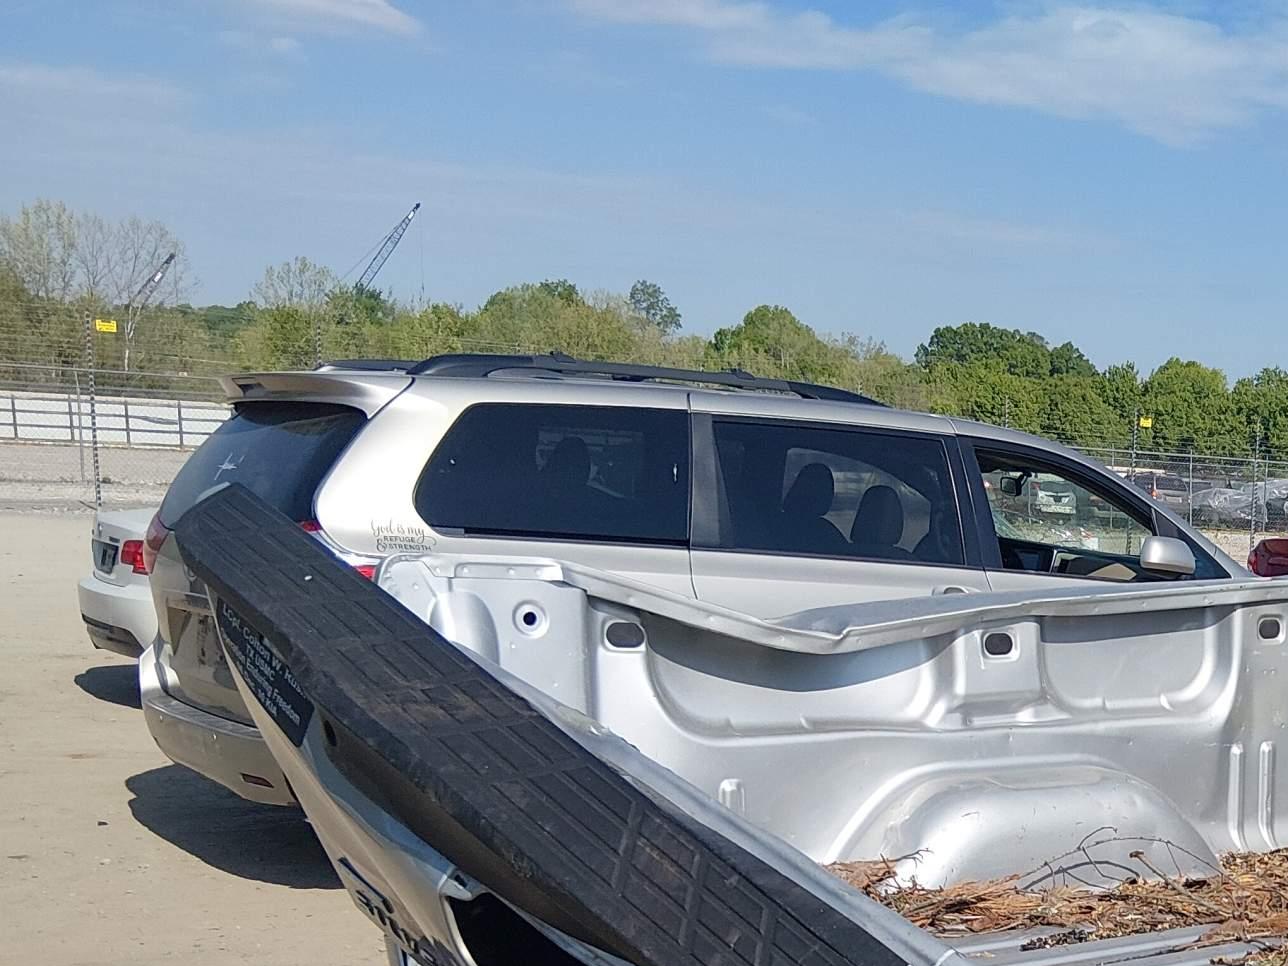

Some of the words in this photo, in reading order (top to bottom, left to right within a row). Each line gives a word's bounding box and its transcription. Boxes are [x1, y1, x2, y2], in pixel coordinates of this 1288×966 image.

[371, 519, 396, 537] God
[397, 523, 404, 534] is
[407, 526, 430, 544] my
[388, 543, 432, 551] STRENGTH
[272, 688, 301, 726] Freedom
